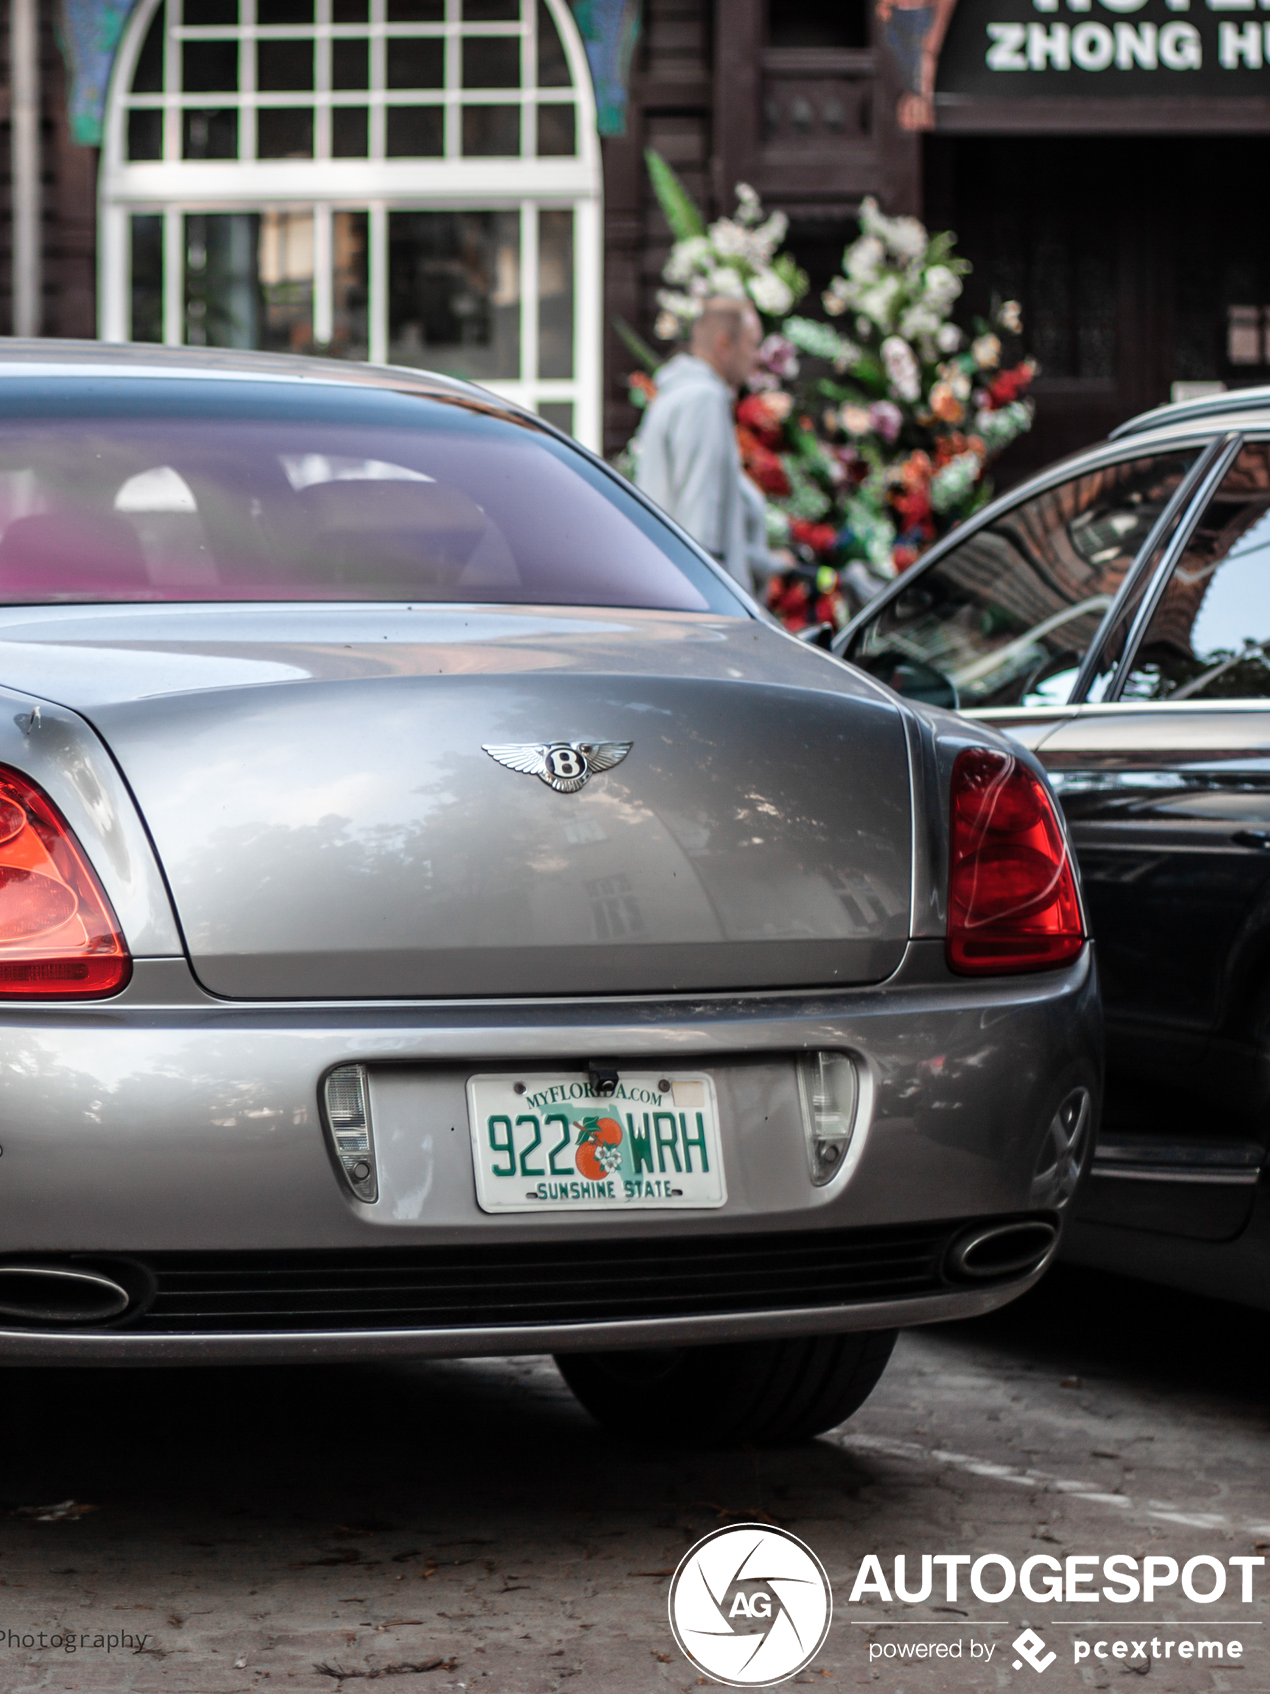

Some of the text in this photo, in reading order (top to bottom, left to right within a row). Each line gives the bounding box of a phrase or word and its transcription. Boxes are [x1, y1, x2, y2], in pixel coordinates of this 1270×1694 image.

[985, 20, 1270, 72] ZHONG H
[550, 749, 581, 776] B
[487, 1111, 709, 1177] 922 WRH
[536, 1180, 673, 1199] SUNSHINE STATE
